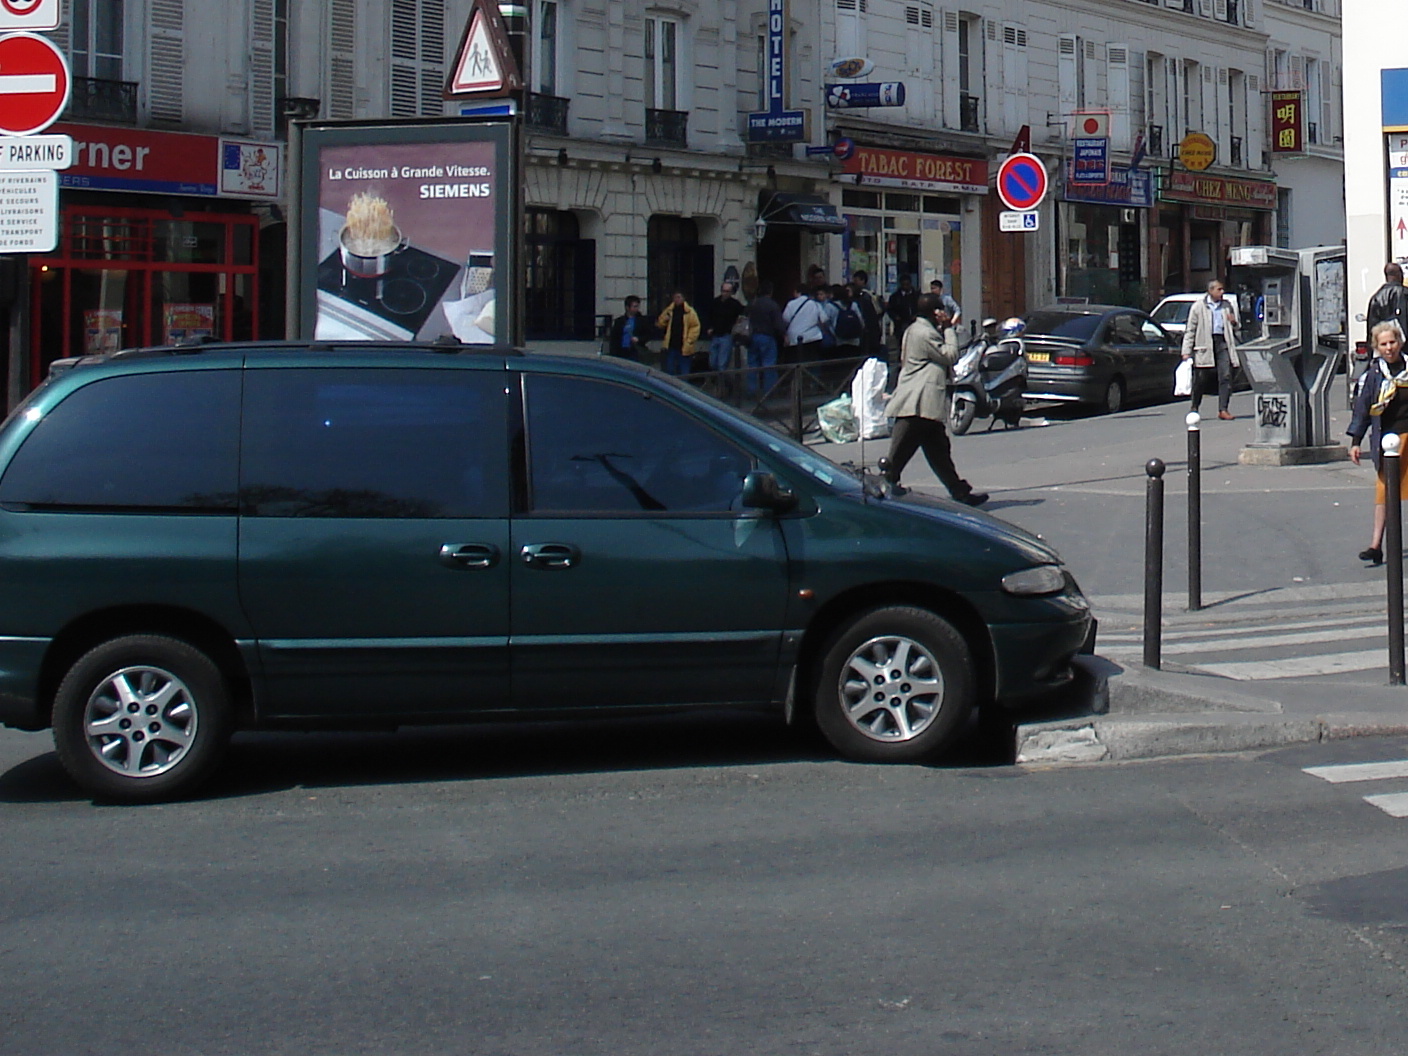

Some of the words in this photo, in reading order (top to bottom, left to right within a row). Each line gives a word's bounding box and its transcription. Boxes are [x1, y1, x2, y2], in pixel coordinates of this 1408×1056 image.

[751, 119, 766, 128] THE
[768, 117, 803, 127] MODERN
[10, 145, 64, 162] PARKING
[72, 141, 150, 171] rner
[329, 168, 342, 179] La
[344, 167, 388, 179] Cuisson
[391, 166, 398, 178] à
[401, 165, 443, 178] Grande
[446, 164, 491, 177] Vitesse.
[858, 152, 908, 177] TABAC
[916, 157, 972, 182] FOREST
[420, 183, 490, 199] SIEMENS
[1195, 180, 1222, 198] CHEZ
[1224, 182, 1251, 200] MENG
